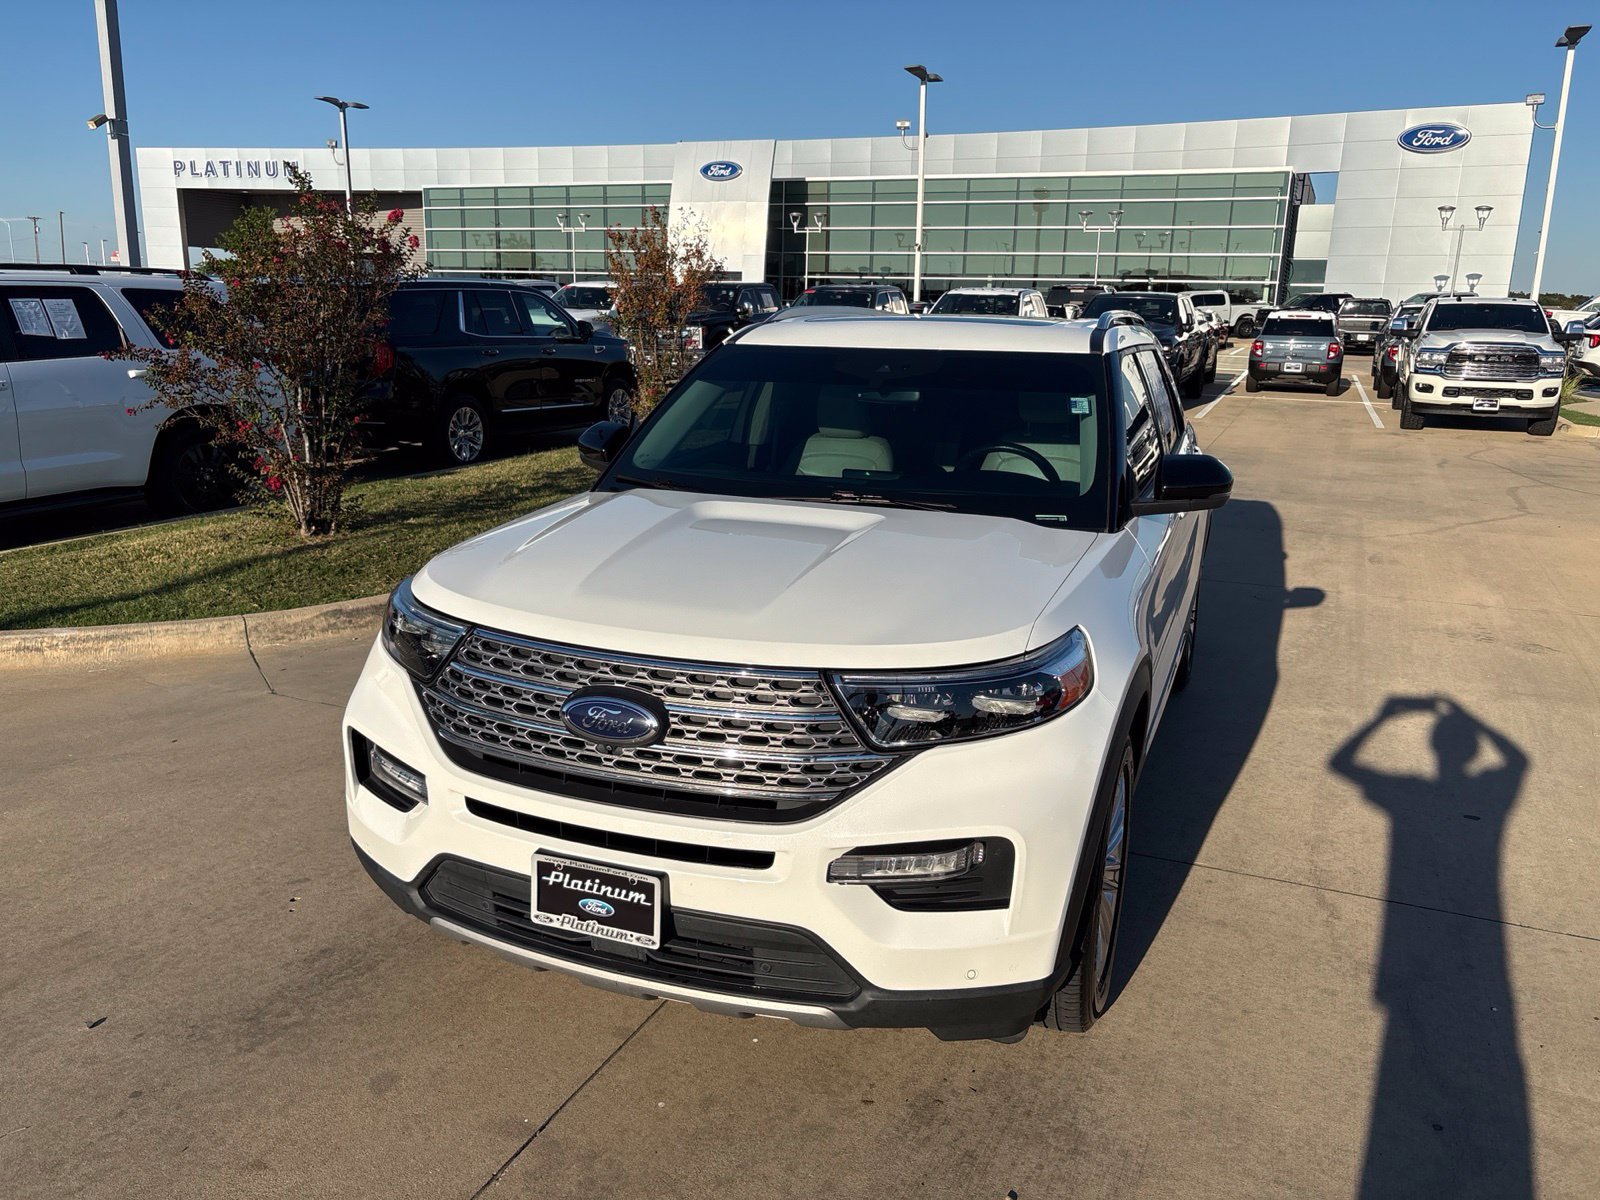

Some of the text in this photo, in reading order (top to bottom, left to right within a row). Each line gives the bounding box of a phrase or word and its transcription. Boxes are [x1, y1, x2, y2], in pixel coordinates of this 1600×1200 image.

[1412, 129, 1455, 147] Ford
[707, 164, 732, 176] Ford
[1474, 354, 1513, 362] RAM
[582, 705, 634, 734] Ford
[542, 870, 652, 906] Platinum
[585, 902, 608, 915] Ford
[560, 915, 634, 942] Platinum
